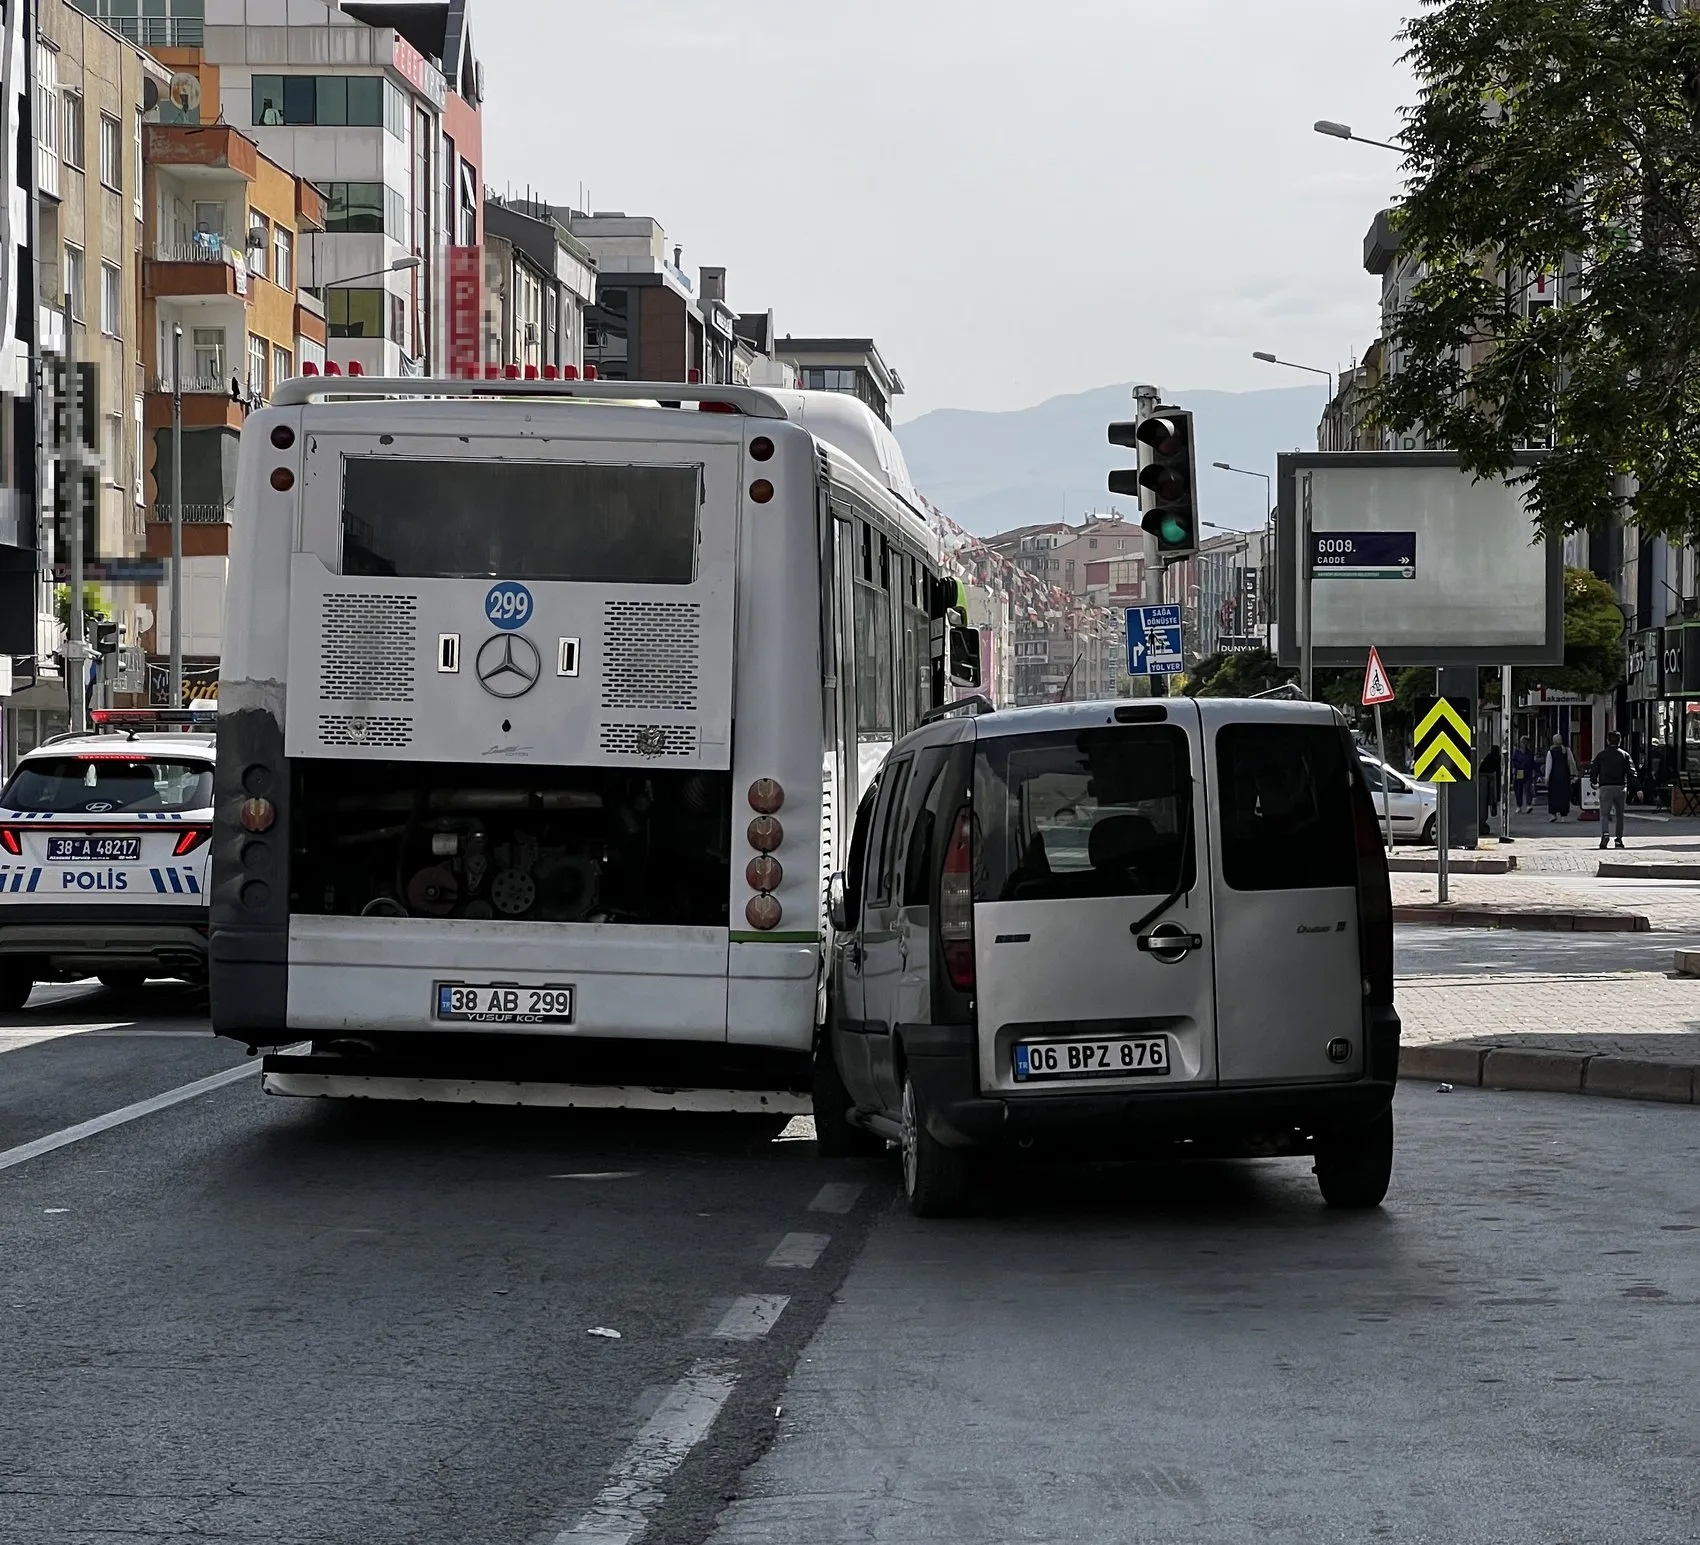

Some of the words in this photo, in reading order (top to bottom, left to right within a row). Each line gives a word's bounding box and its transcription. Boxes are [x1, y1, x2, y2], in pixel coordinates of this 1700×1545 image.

[1318, 539, 1357, 553] 6009.
[1317, 556, 1346, 564] CADDE
[489, 591, 529, 620] 299
[1152, 608, 1172, 617] SAĞA
[1151, 663, 1166, 671] YOL
[56, 840, 73, 855] 38
[82, 840, 91, 855] A
[96, 840, 137, 855] 48217
[62, 867, 128, 890] POLİS
[451, 989, 478, 1011] 38
[487, 990, 519, 1012] AB
[528, 992, 568, 1013] 299
[467, 1013, 513, 1021] YUSUF
[1018, 1061, 1028, 1069] TR
[1029, 1047, 1058, 1071] 06
[1067, 1045, 1111, 1069] BPZ
[1119, 1042, 1163, 1066] 876
